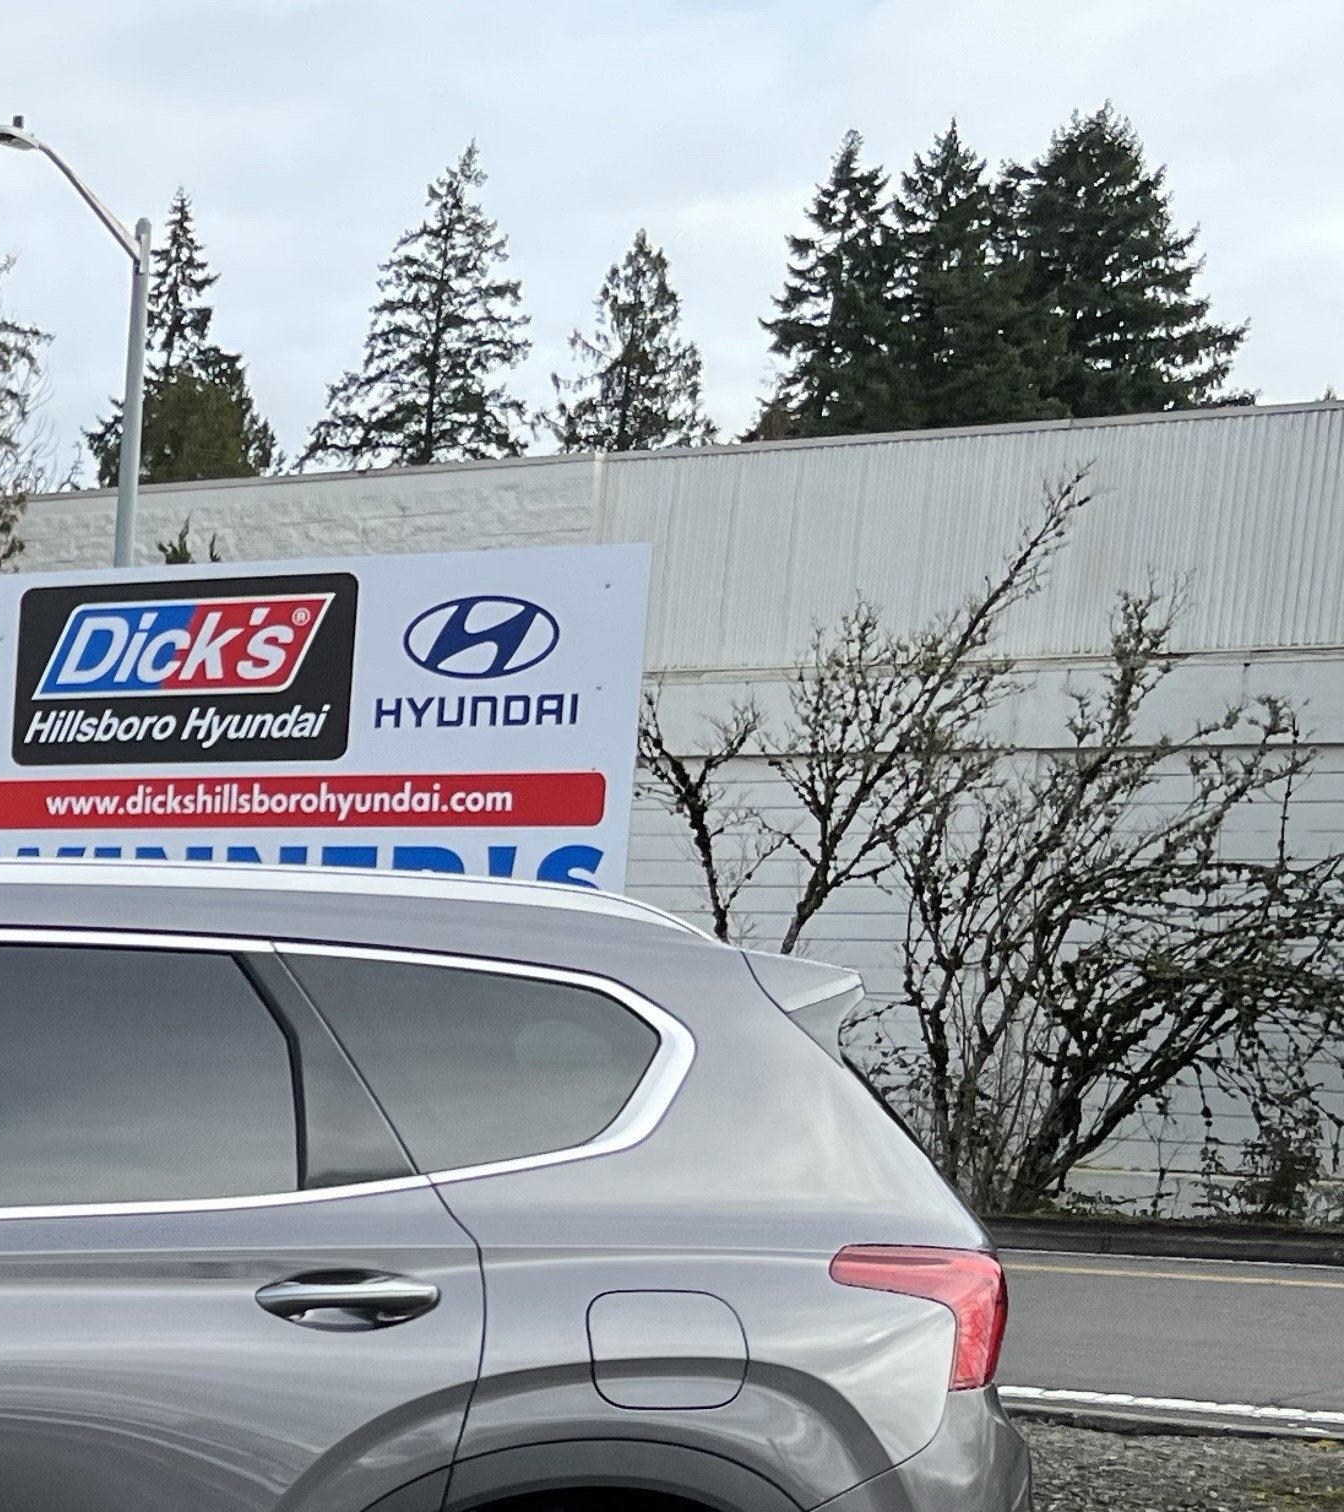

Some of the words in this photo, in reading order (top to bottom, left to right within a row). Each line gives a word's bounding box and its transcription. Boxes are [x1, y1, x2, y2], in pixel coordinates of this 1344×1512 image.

[24, 708, 178, 744] Hillsboro
[180, 703, 331, 749] Hyundai
[374, 693, 579, 729] HYUNDAI
[45, 781, 513, 821] www.dickshillsborohyundai.com
